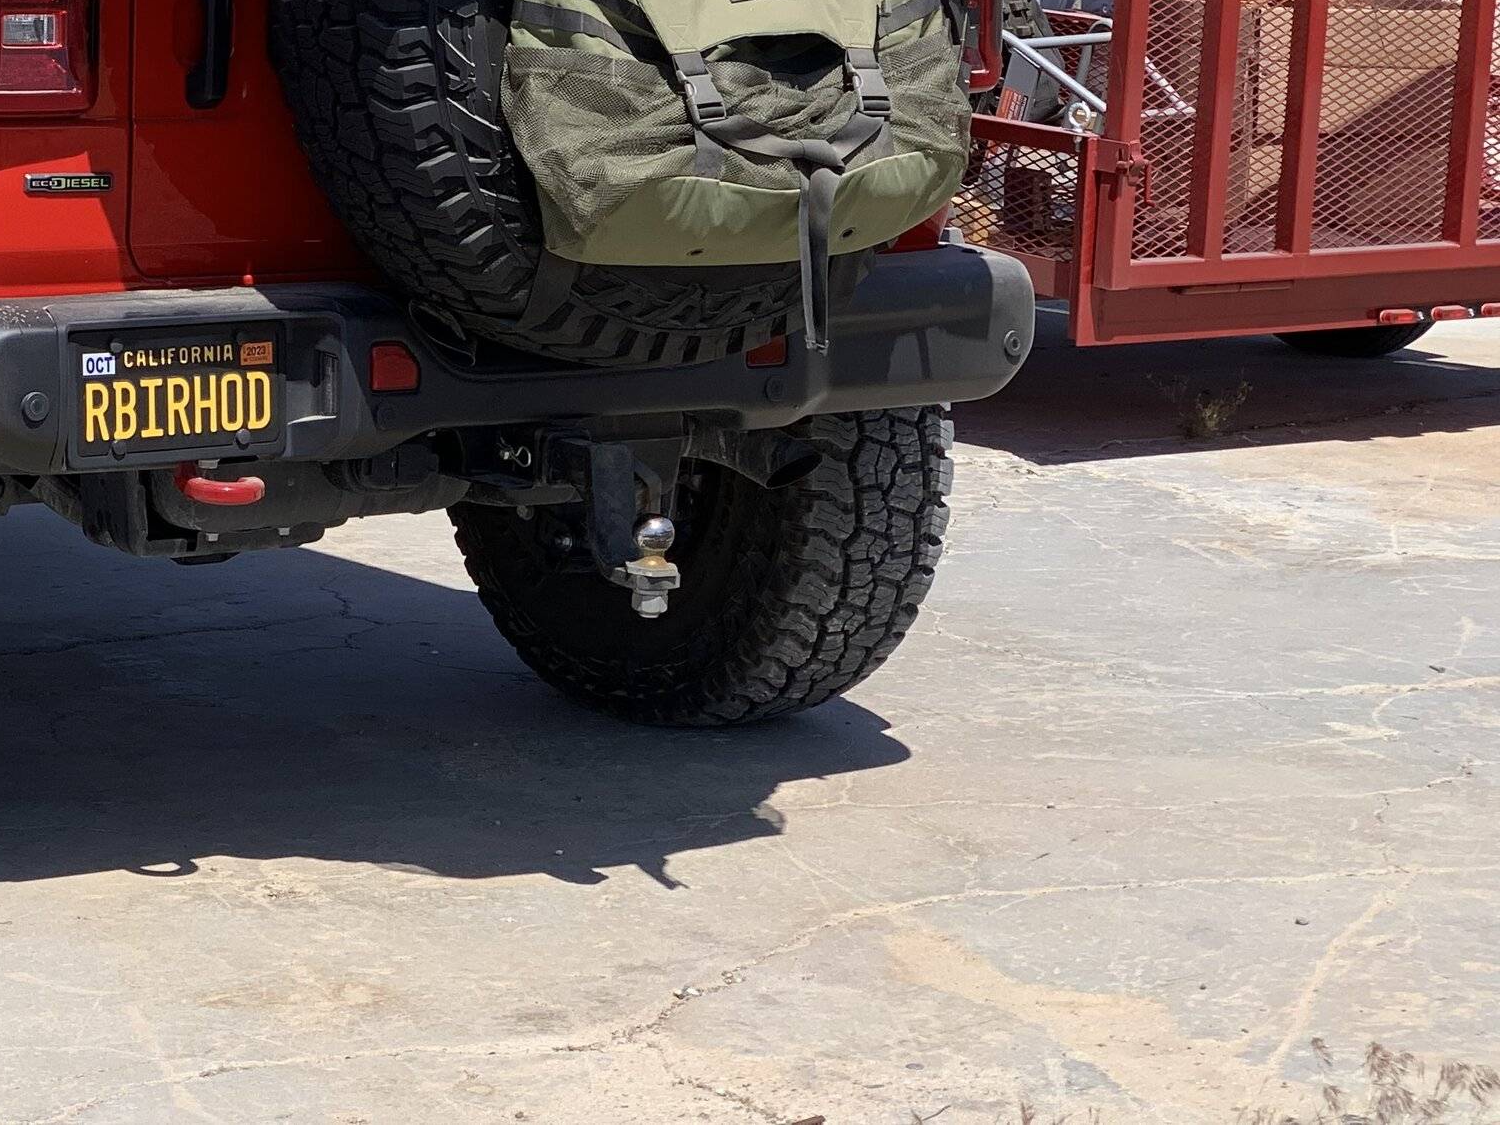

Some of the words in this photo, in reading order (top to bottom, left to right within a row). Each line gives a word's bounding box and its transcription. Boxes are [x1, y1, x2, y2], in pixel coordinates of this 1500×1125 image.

[123, 344, 234, 368] CALIFORNIA
[246, 345, 266, 356] 2023
[85, 356, 113, 374] OCT
[84, 371, 272, 442] RBIRHOD
